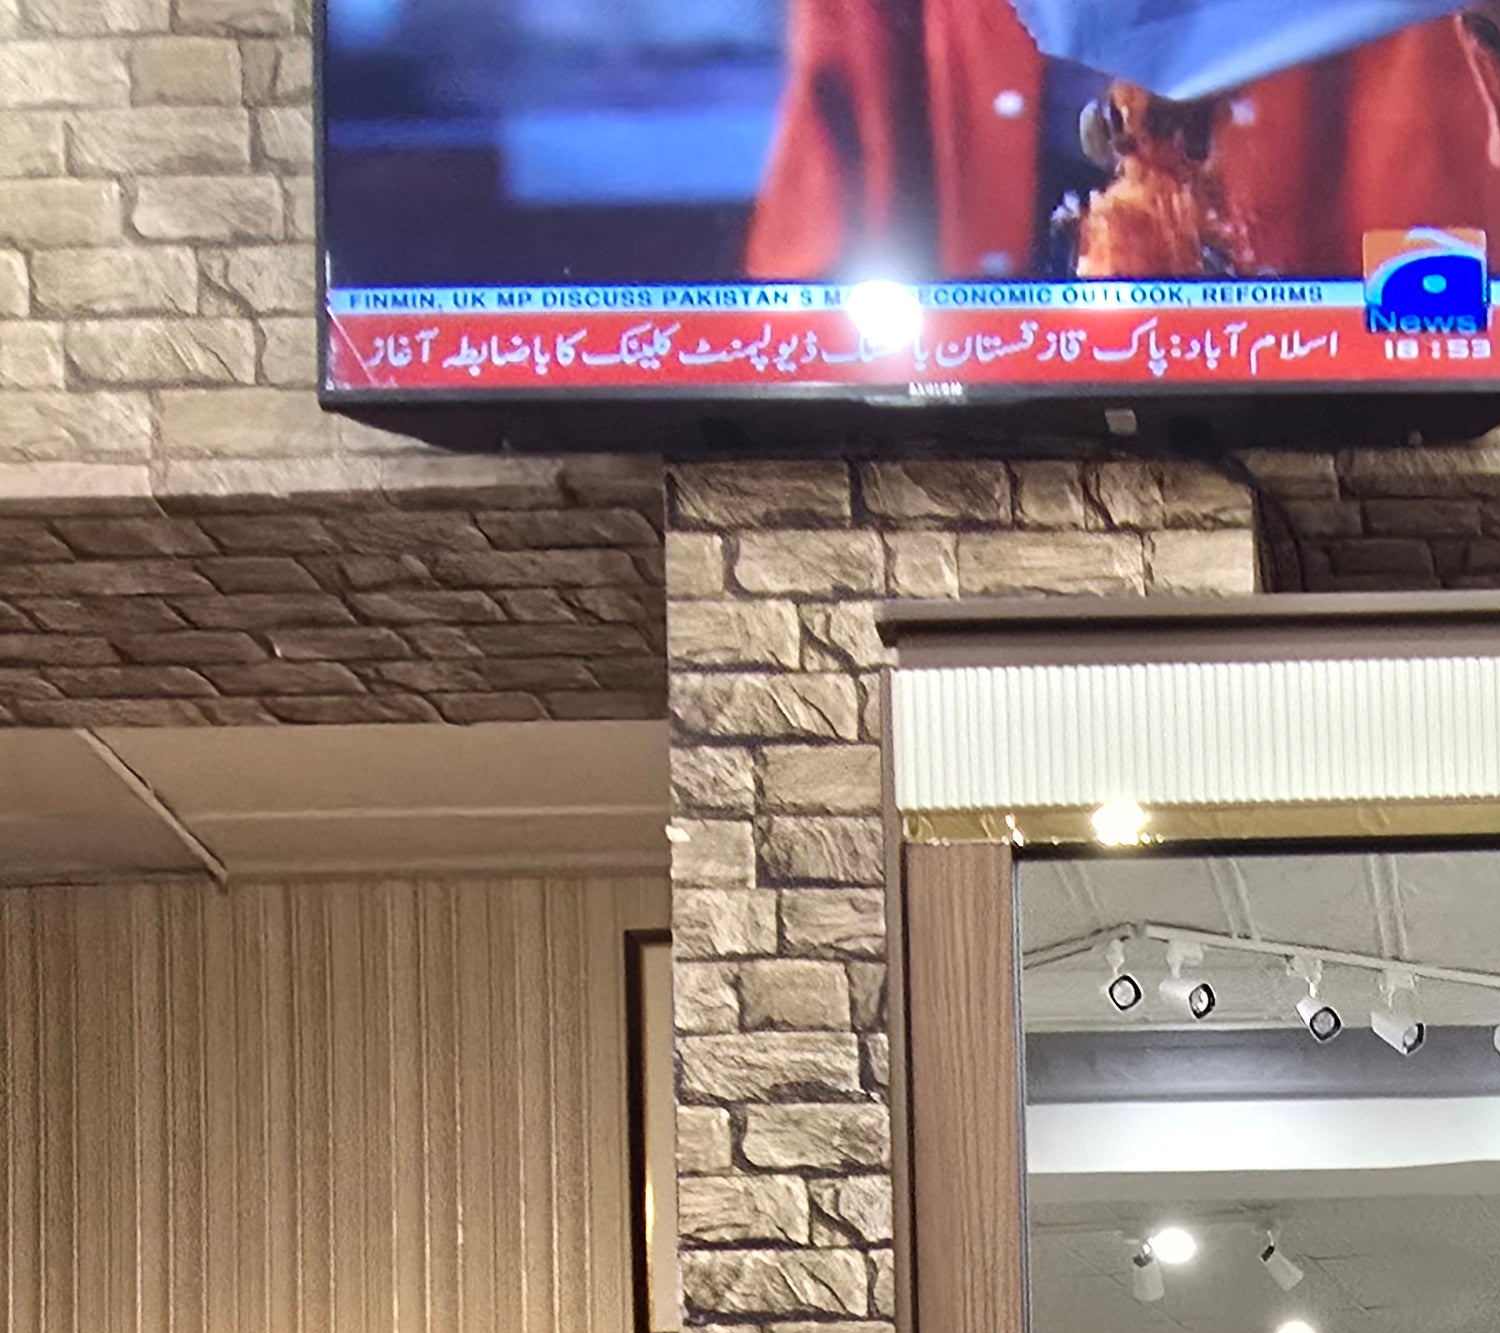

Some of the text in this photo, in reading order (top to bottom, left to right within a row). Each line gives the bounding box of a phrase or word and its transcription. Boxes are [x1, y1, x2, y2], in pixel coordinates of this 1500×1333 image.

[453, 291, 486, 308] UK
[499, 291, 532, 308] MP
[542, 289, 652, 308] DISCUSS
[1203, 286, 1323, 303] REFORMS
[1370, 307, 1477, 334] News
[365, 326, 440, 367] آغاز
[555, 328, 588, 367] کا
[581, 321, 681, 370] کلینک
[1093, 316, 1168, 377] پاک
[1250, 329, 1339, 376] اسلام
